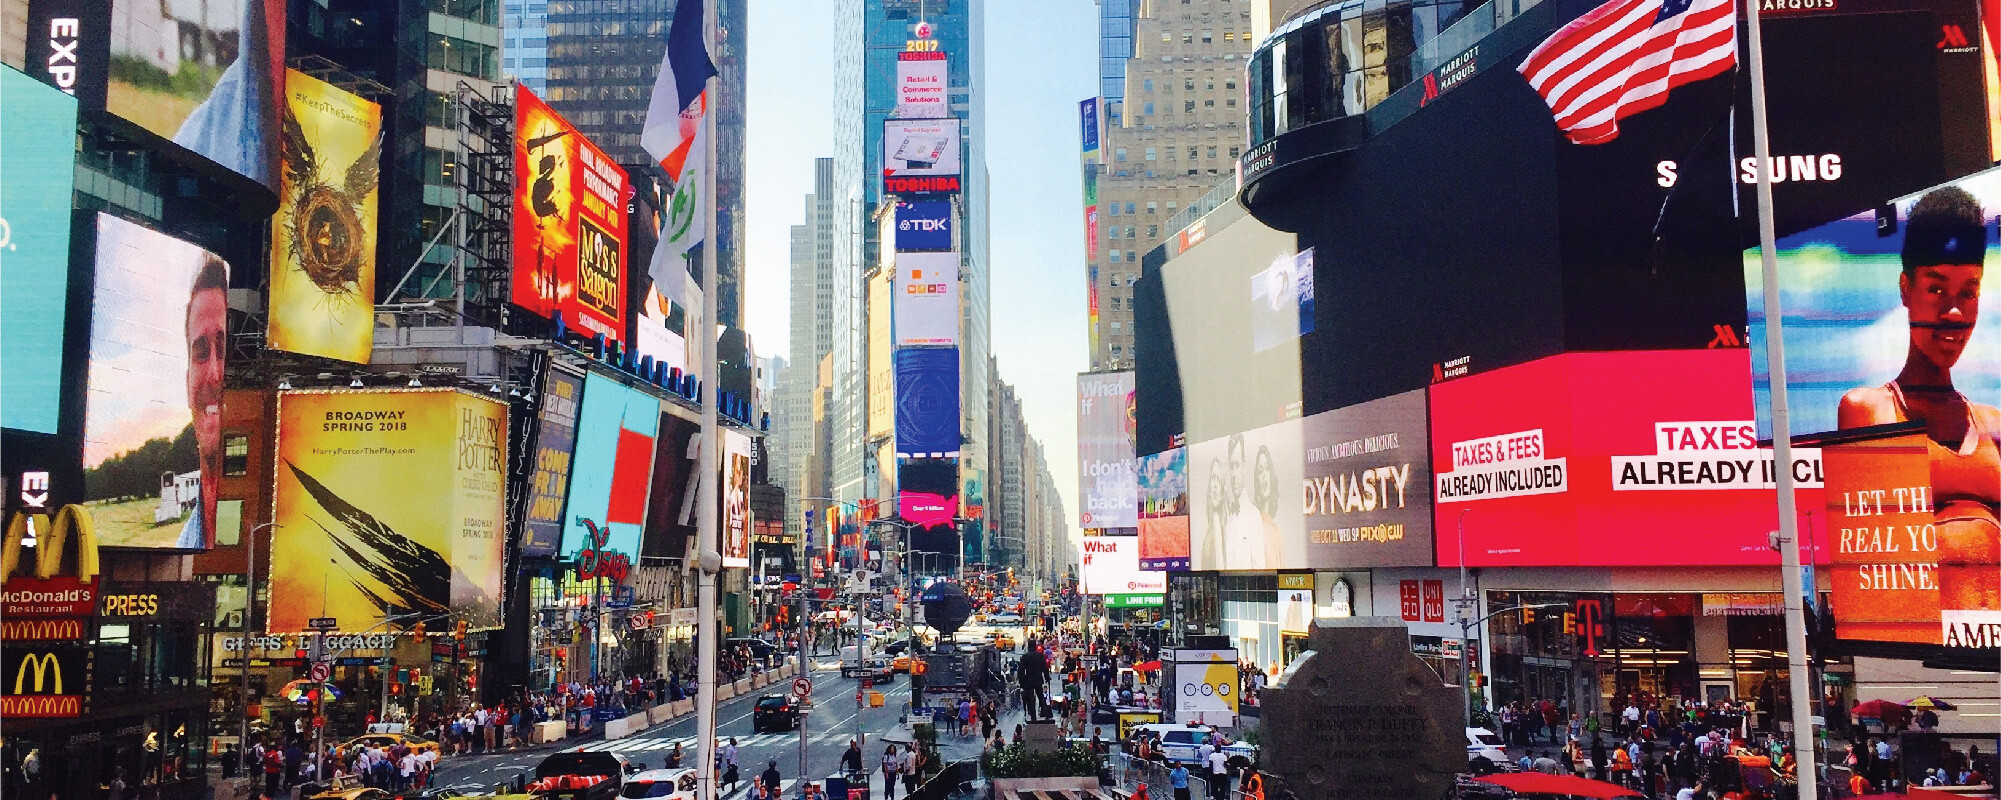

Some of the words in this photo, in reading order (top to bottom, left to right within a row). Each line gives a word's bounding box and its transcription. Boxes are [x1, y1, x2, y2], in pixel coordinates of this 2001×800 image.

[1757, 0, 1834, 10] ARQUIS
[906, 40, 938, 52] 2017
[49, 17, 79, 96] EXP
[898, 52, 945, 60] TOSHIBA
[1440, 45, 1480, 77] MARRIOTT
[1440, 62, 1476, 91] MARQUIS
[295, 92, 372, 130] #KeepTheSecrets
[1242, 140, 1279, 166] MARRIOTT
[1243, 154, 1274, 177] MARQUIS
[1657, 153, 1842, 188] SSUNG
[885, 177, 960, 192] TOSHIBA
[910, 218, 947, 231] TDK
[580, 257, 617, 310] Saigon
[1080, 380, 1123, 398] What
[325, 410, 405, 421] BROADWAY
[1082, 398, 1092, 416] if
[322, 422, 373, 432] SPRING
[379, 421, 407, 431] 2018
[462, 407, 500, 443] HARRY
[1661, 425, 1757, 451] TAXES
[312, 447, 416, 457] HarryPotterThePlay.com
[457, 436, 502, 474] POTTER
[538, 447, 570, 473] COME
[1455, 440, 1493, 467] TAXES
[1497, 438, 1504, 461] &
[1508, 434, 1541, 460] FEES
[1440, 468, 1494, 499] ALREADY
[1495, 464, 1562, 494] INCLUDED
[1620, 460, 1754, 485] ALREADY
[1762, 459, 1824, 484] ICL
[1302, 463, 1410, 516] DYNASTY
[530, 495, 563, 521] AWAY
[1086, 492, 1133, 511] back.
[1843, 489, 1885, 517] LET
[463, 517, 493, 528] BROADWAY
[462, 528, 481, 539] SPRING
[482, 528, 493, 539] 2018
[1839, 526, 1900, 554] REAL
[1083, 541, 1117, 554] What
[1083, 554, 1092, 566] if
[0, 589, 91, 604] McDonald's
[1425, 585, 1440, 599] UNI
[9, 604, 73, 613] Restaurant
[1425, 603, 1441, 620] QLO
[298, 635, 395, 651] LGGAGE
